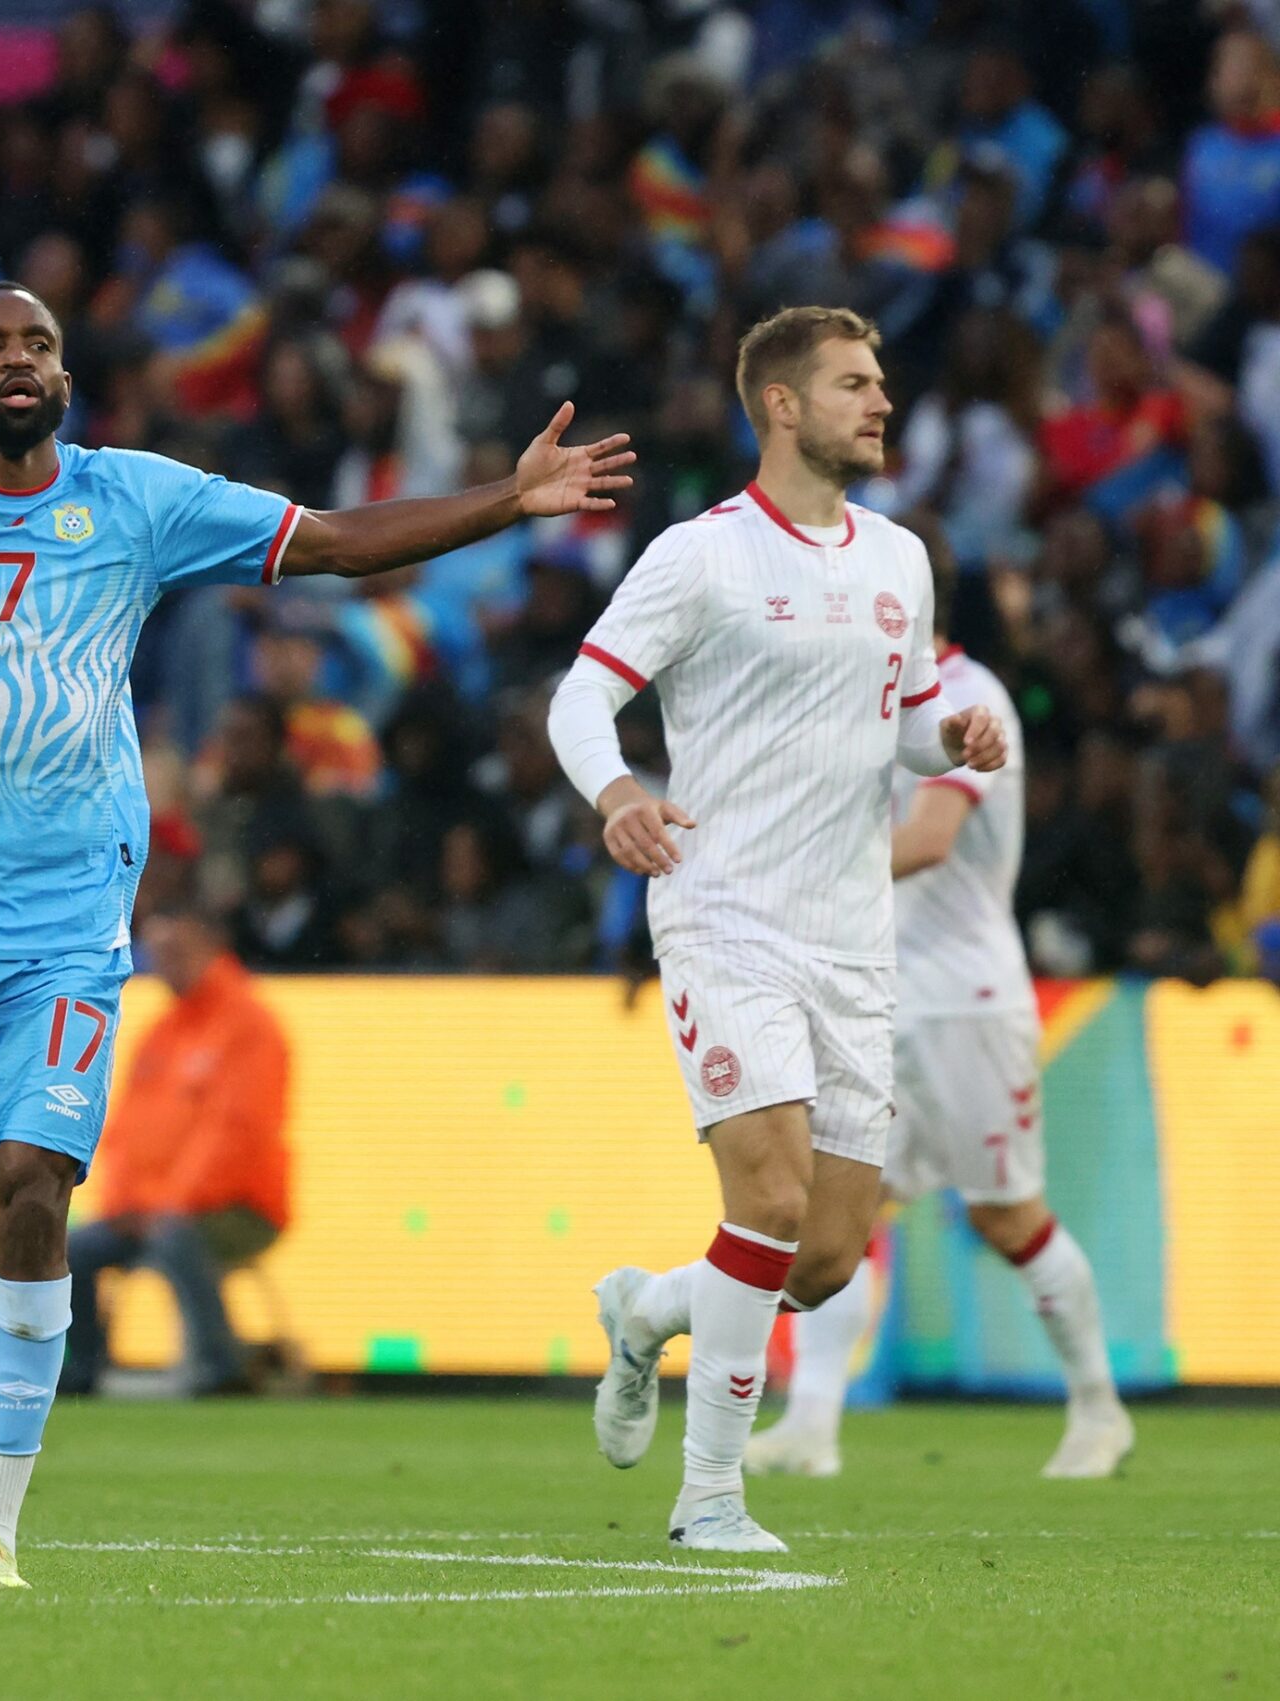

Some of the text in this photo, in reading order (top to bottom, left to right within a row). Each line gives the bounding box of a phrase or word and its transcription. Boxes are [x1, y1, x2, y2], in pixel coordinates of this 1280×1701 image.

[881, 653, 902, 720] 2
[46, 997, 107, 1075] 17
[46, 1101, 81, 1120] umbro
